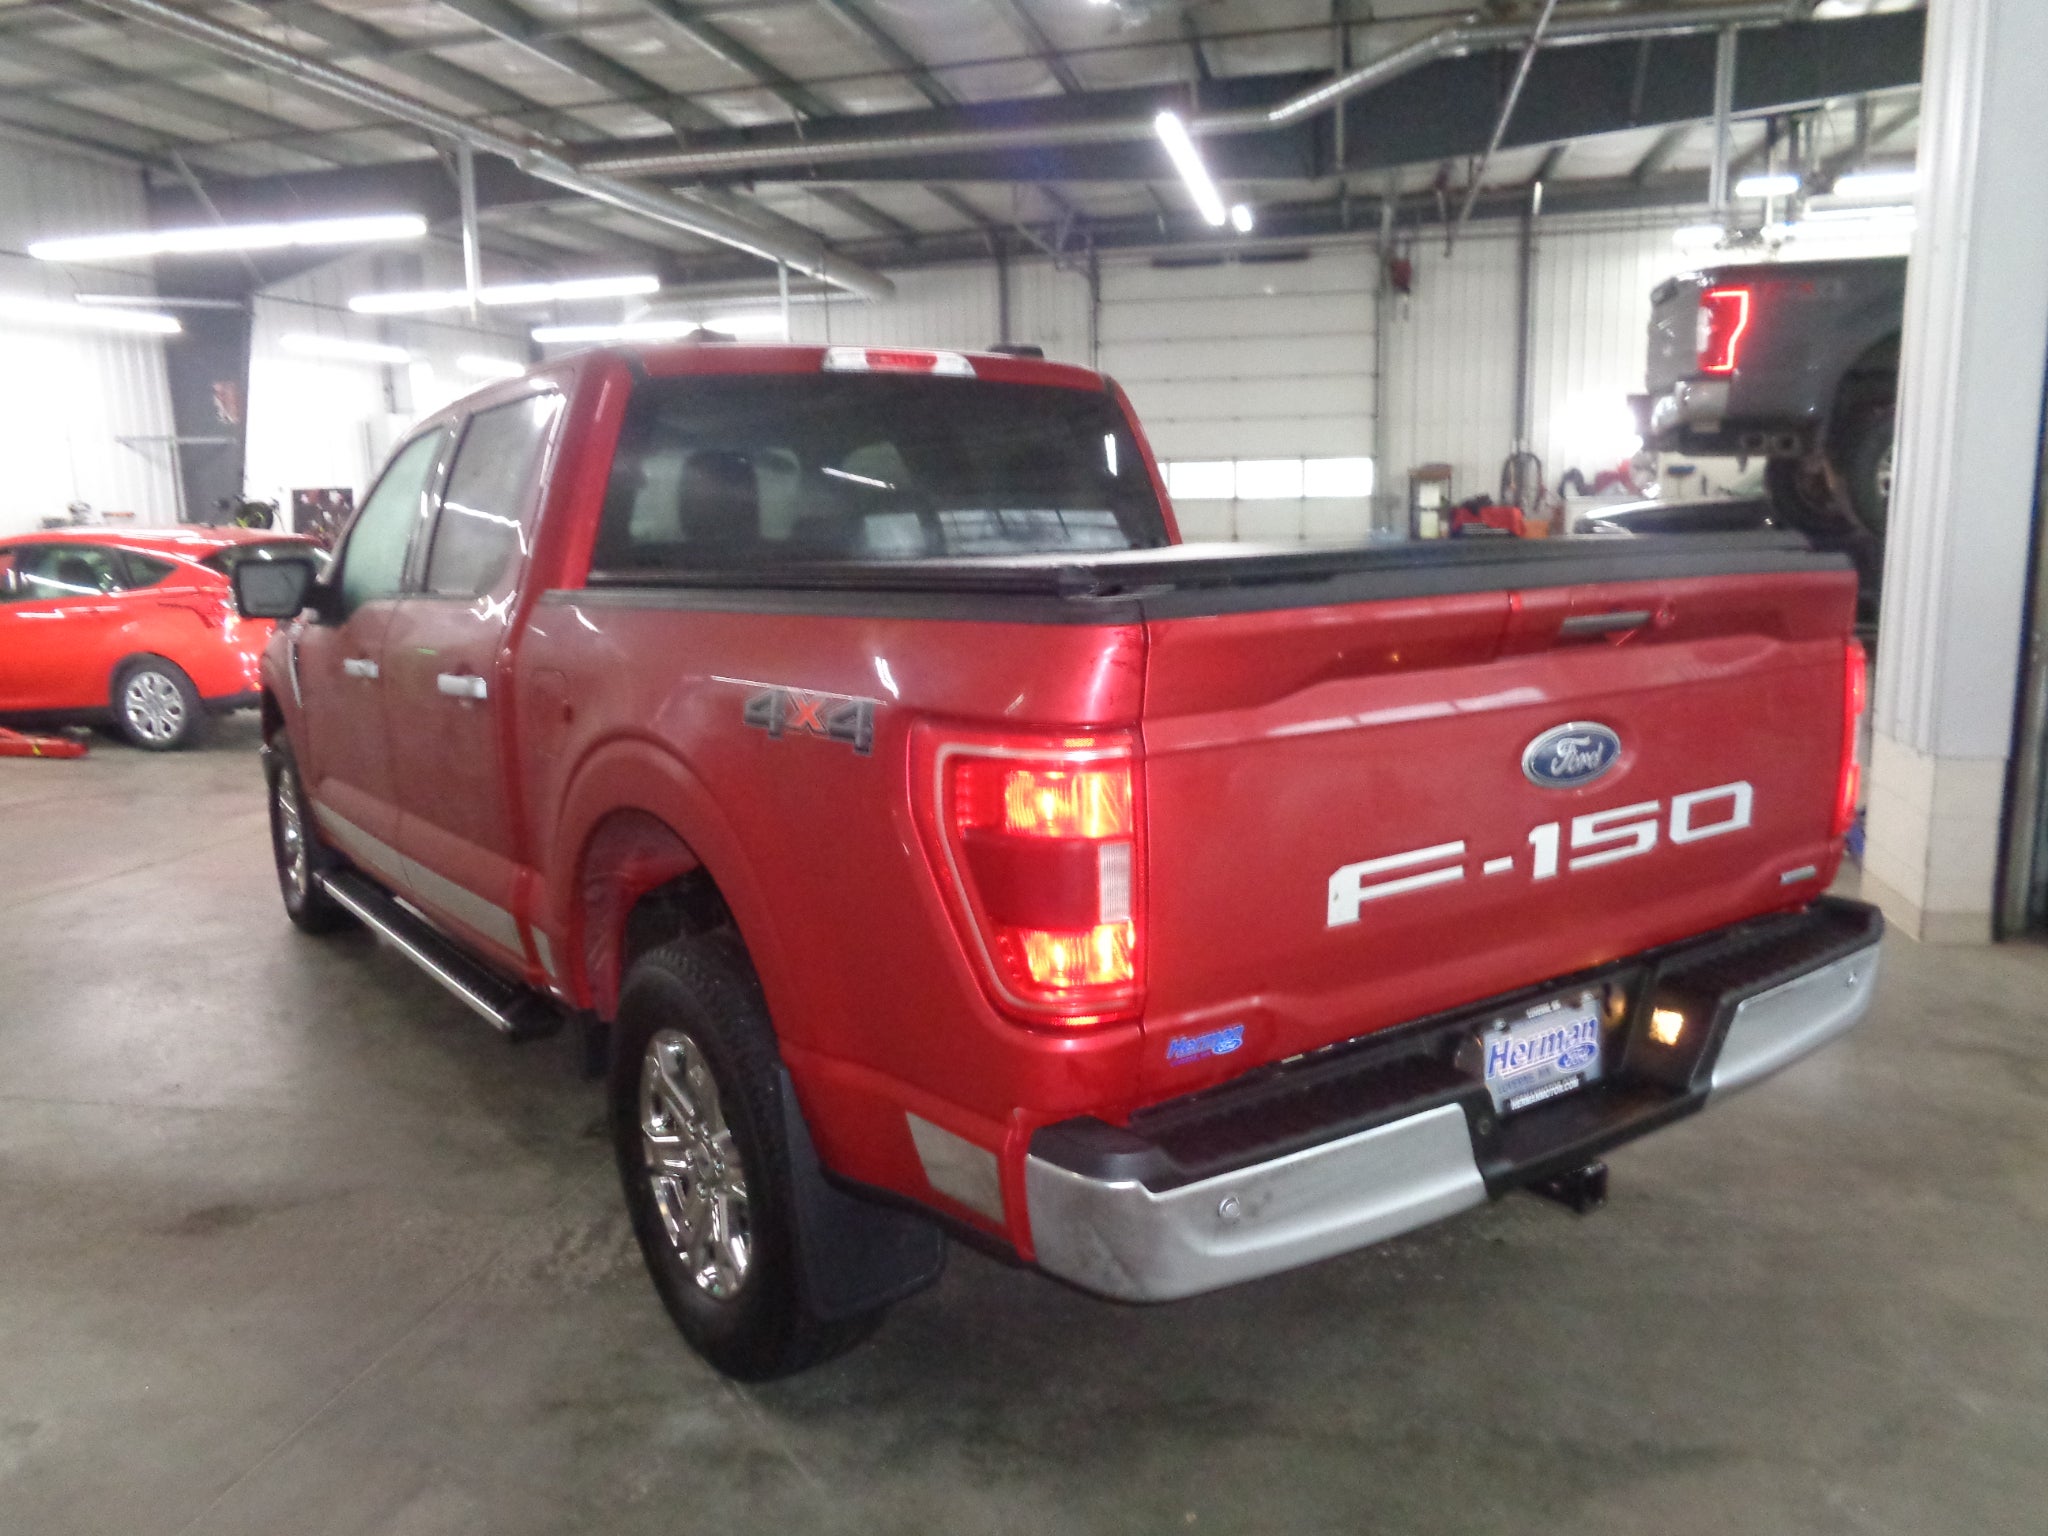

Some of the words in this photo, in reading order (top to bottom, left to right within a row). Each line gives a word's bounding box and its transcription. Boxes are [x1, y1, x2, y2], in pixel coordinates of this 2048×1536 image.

[1551, 735, 1604, 776] Ford
[1326, 780, 1754, 928] F-150
[1487, 1018, 1598, 1079] Herman
